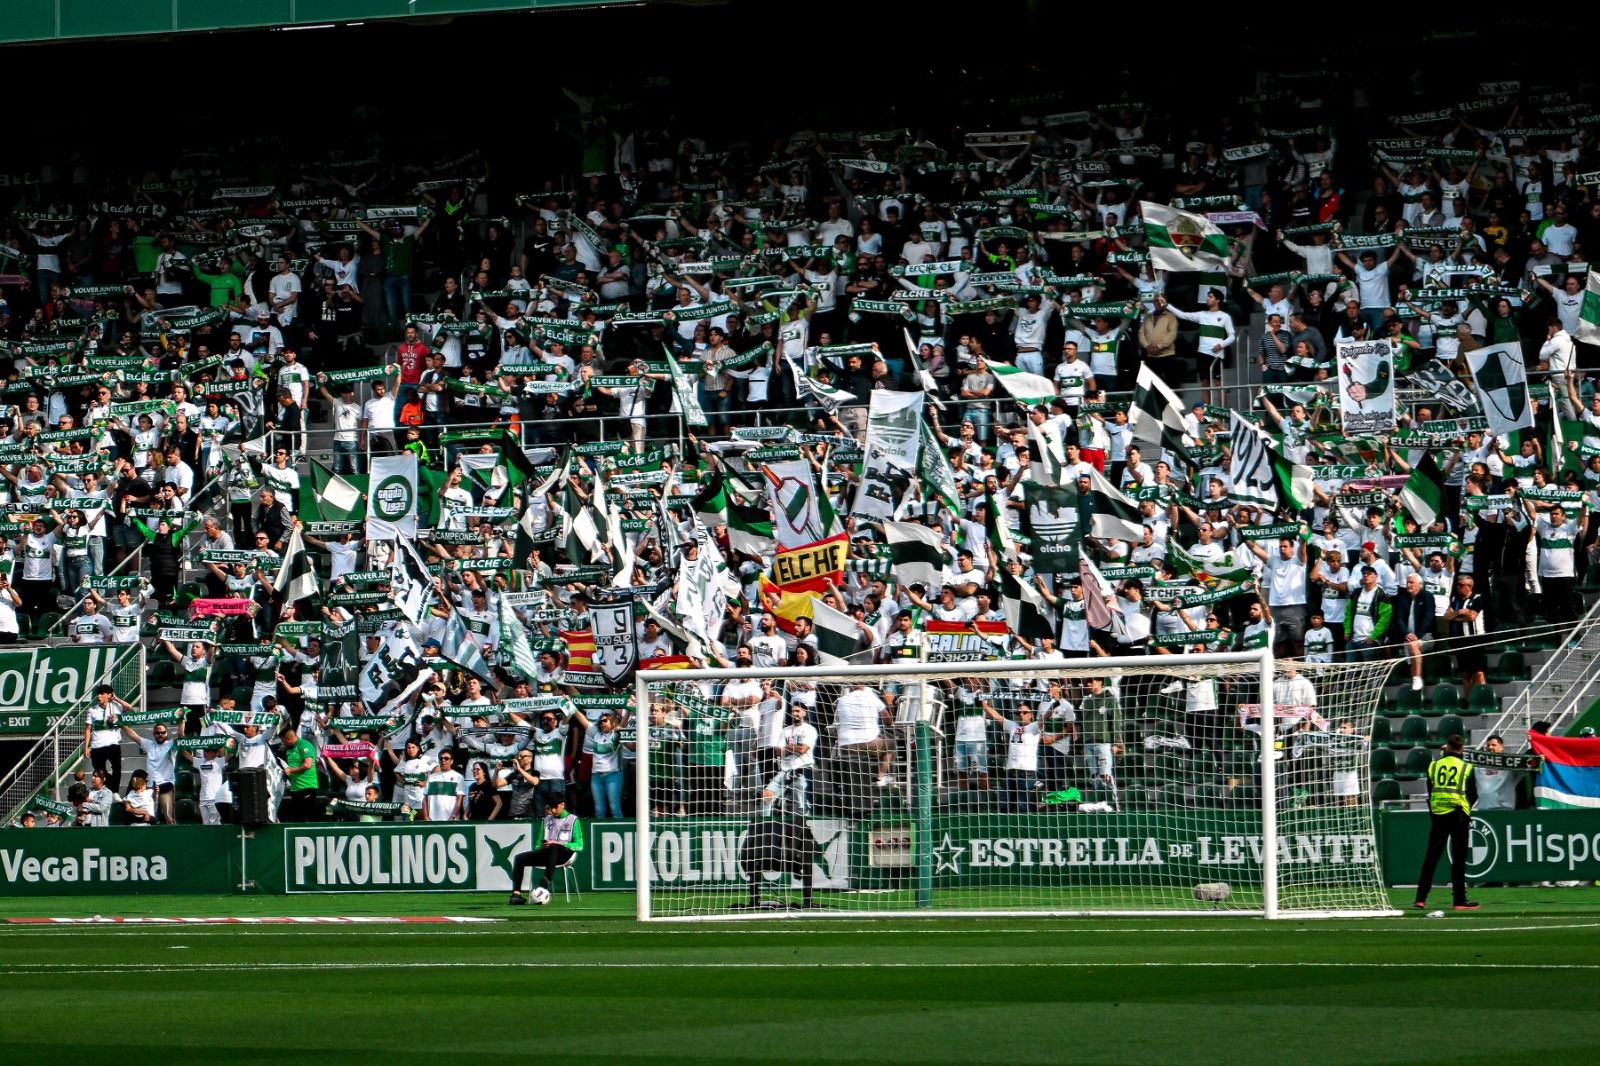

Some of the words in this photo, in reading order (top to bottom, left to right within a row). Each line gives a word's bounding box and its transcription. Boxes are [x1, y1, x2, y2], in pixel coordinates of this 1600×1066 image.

[1418, 289, 1467, 297] ELCHE
[174, 319, 195, 327] VOLVER
[551, 318, 579, 326] JUNTOS
[546, 330, 574, 342] ELCHE
[57, 375, 80, 383] VOLVER
[330, 371, 357, 381] VOLVER
[356, 368, 383, 378] JUNTOS
[590, 377, 621, 386] ELCHE
[210, 383, 234, 394] ELCHE
[110, 403, 132, 414] ELCHE
[40, 430, 66, 441] VOLVER
[66, 427, 90, 438] JUNTOS
[1391, 437, 1429, 446] ELCHE
[597, 444, 620, 452] JUNTOS
[1523, 487, 1550, 498] VOLVER
[1550, 489, 1582, 498] JUNTOS
[51, 499, 80, 508] ELCHE
[1335, 495, 1371, 505] ELCHE
[1268, 525, 1298, 535] JUNTOS
[1398, 536, 1425, 544] VOLVER
[1040, 544, 1071, 553] elche
[462, 559, 499, 568] ELCHE
[777, 545, 841, 583] ELCHE
[347, 572, 377, 580] VOLVER
[1126, 566, 1155, 576] JUNTOS
[1184, 595, 1211, 606] VOLVER
[1211, 586, 1240, 600] JUNTOS
[161, 618, 185, 626] VOLVER
[162, 630, 188, 639] ELCHE
[1184, 632, 1216, 641] JUNTOS
[441, 707, 469, 716] VOLVER
[469, 705, 498, 715] JUNTOS
[121, 713, 147, 722] VOLVER
[146, 710, 172, 721] JUNTOS
[9, 717, 31, 726] EXIT
[333, 718, 361, 726] VOLVER
[176, 738, 200, 747] VOLVER
[201, 737, 226, 745] JUNTOS
[1463, 752, 1503, 766] ELCHE
[1506, 757, 1521, 767] CF
[1437, 766, 1458, 786] 62
[968, 837, 1163, 867] ESTRELLA
[1168, 844, 1193, 857] DE
[295, 834, 468, 884] PIKOLINOS
